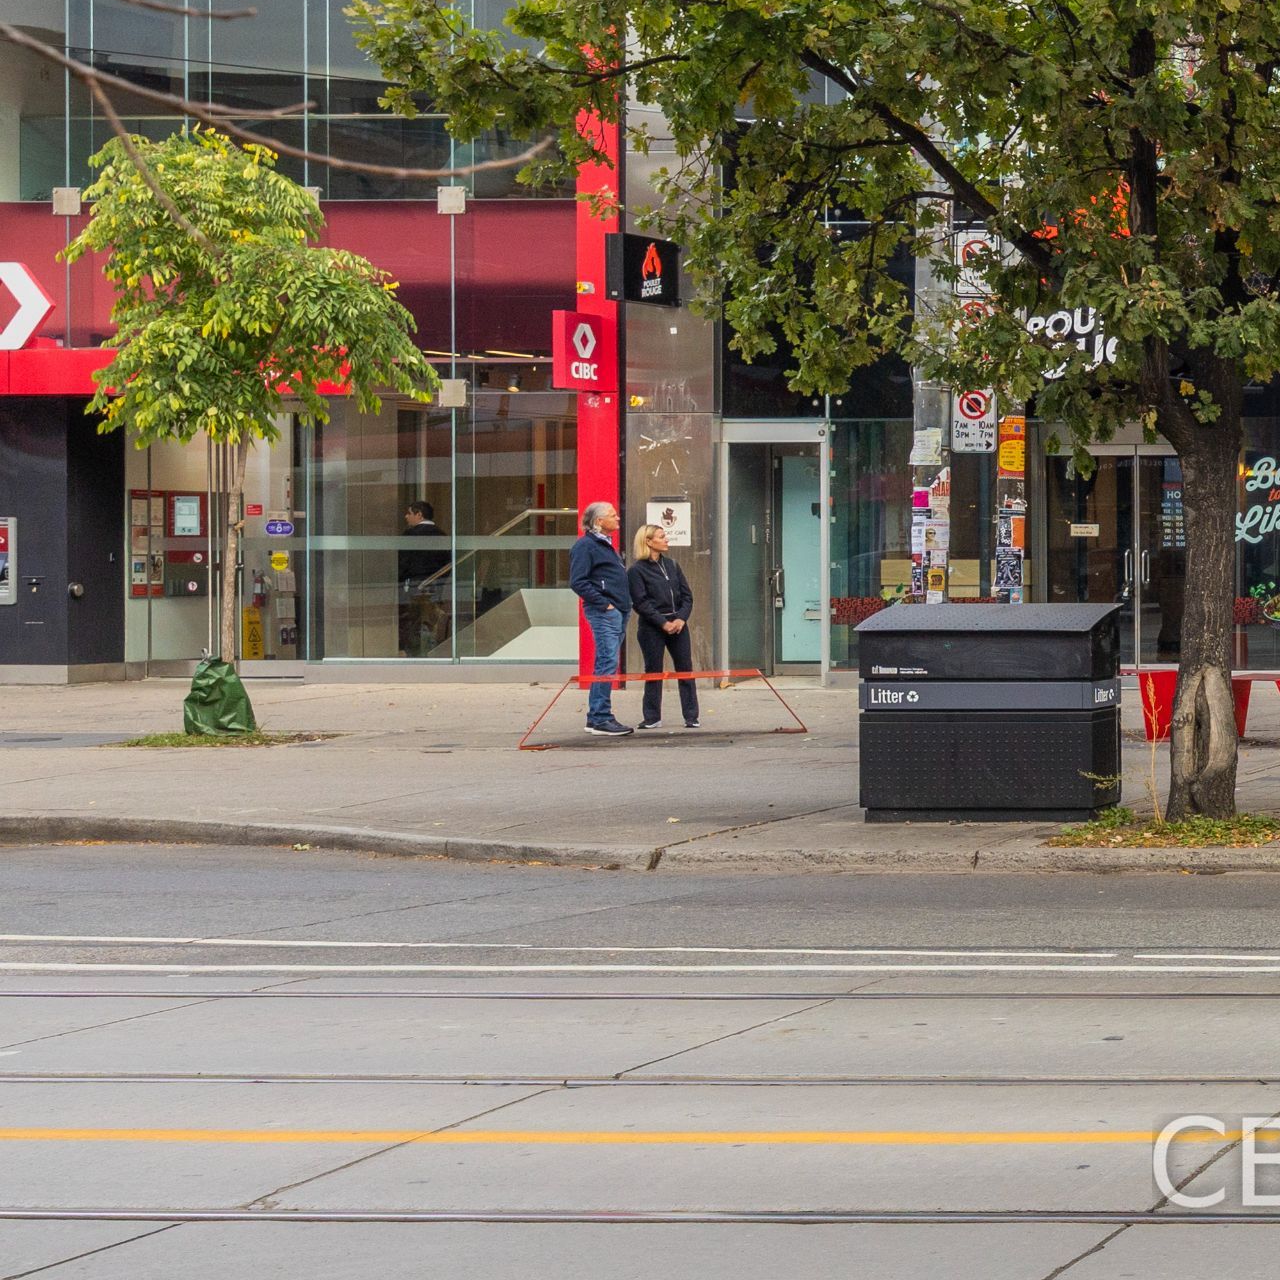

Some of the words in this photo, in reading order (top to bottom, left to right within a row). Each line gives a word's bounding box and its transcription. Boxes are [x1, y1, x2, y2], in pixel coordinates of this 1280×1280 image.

[641, 285, 662, 298] ROUGE
[571, 361, 598, 381] CIBC
[954, 420, 969, 429] 7AM
[978, 420, 994, 429] 10AM
[955, 430, 969, 438] 3PM
[979, 430, 994, 438] 7PM
[871, 688, 904, 704] Litter
[1094, 687, 1108, 703] Litter
